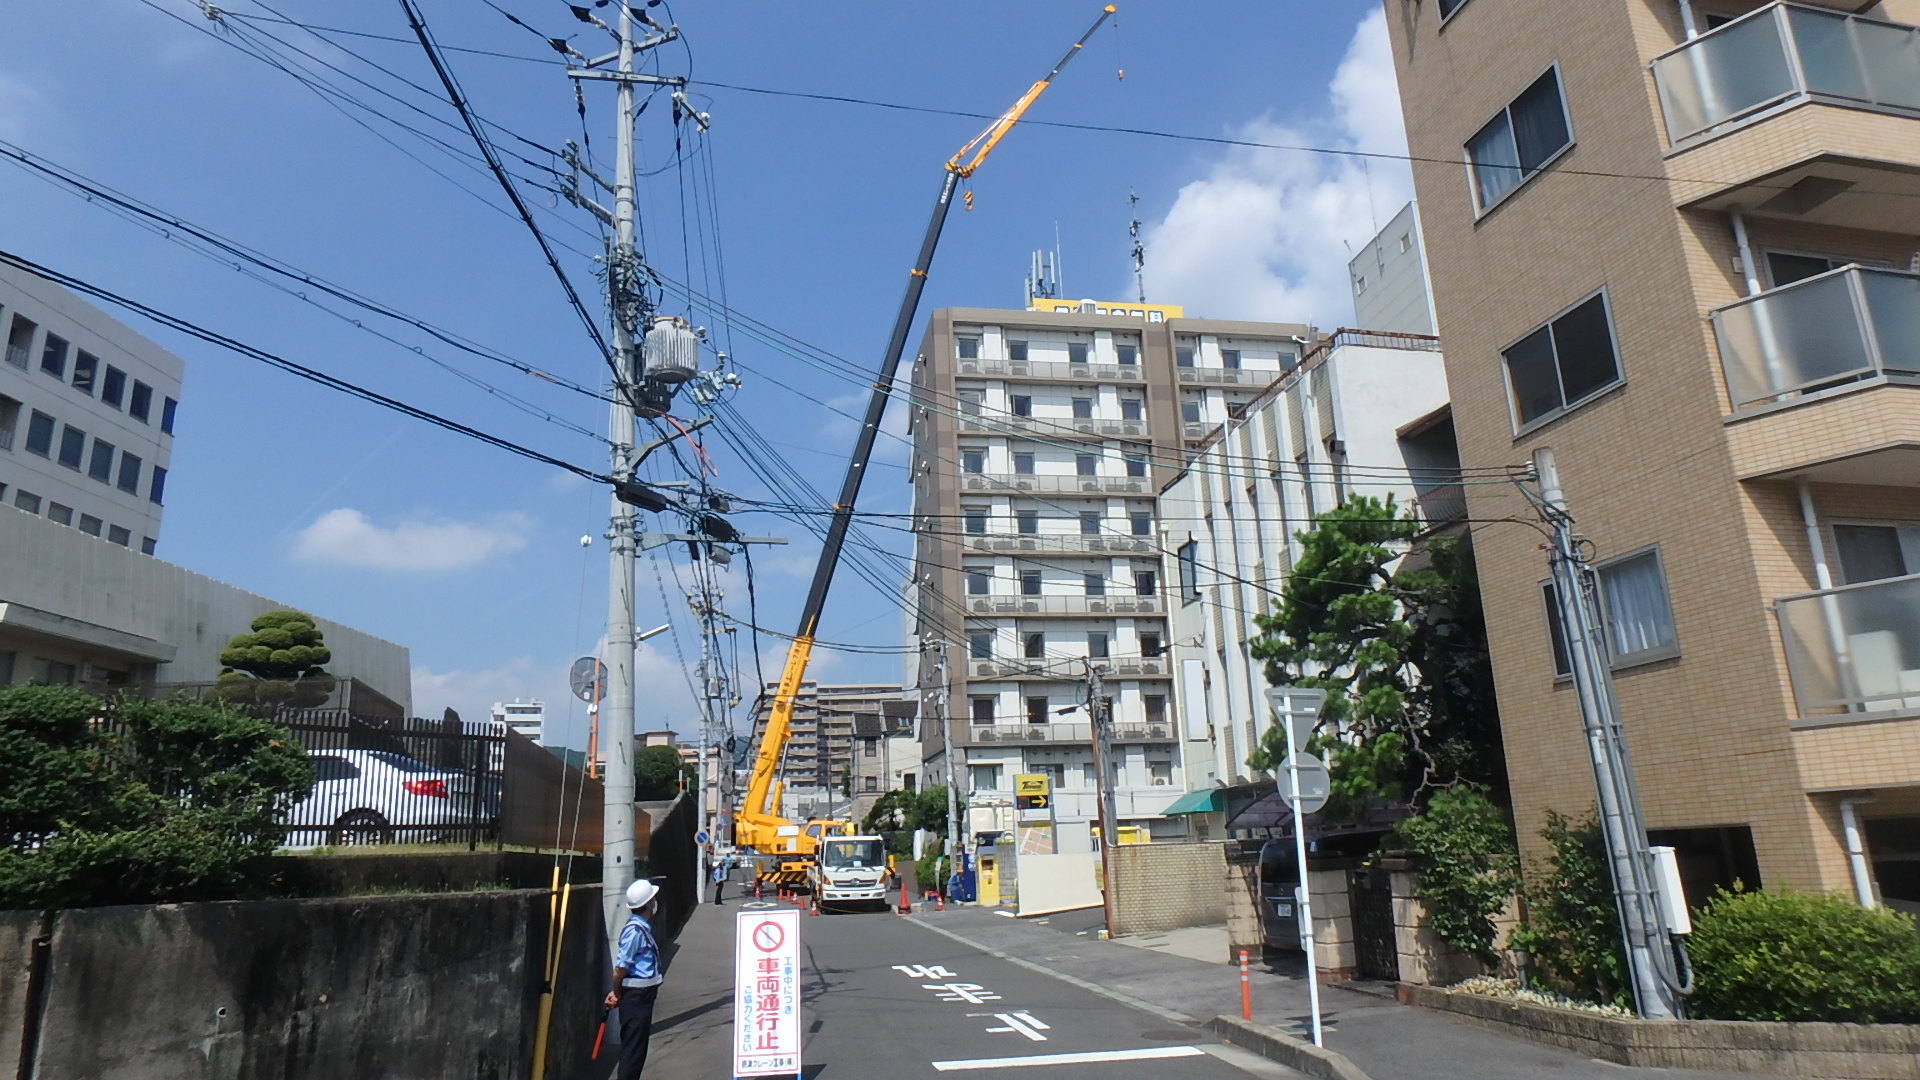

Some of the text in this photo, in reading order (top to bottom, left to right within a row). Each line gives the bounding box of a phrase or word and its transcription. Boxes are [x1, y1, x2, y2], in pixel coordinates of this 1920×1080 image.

[756, 957, 780, 1050] 車両通行止
[784, 957, 793, 1014] 工事中につき
